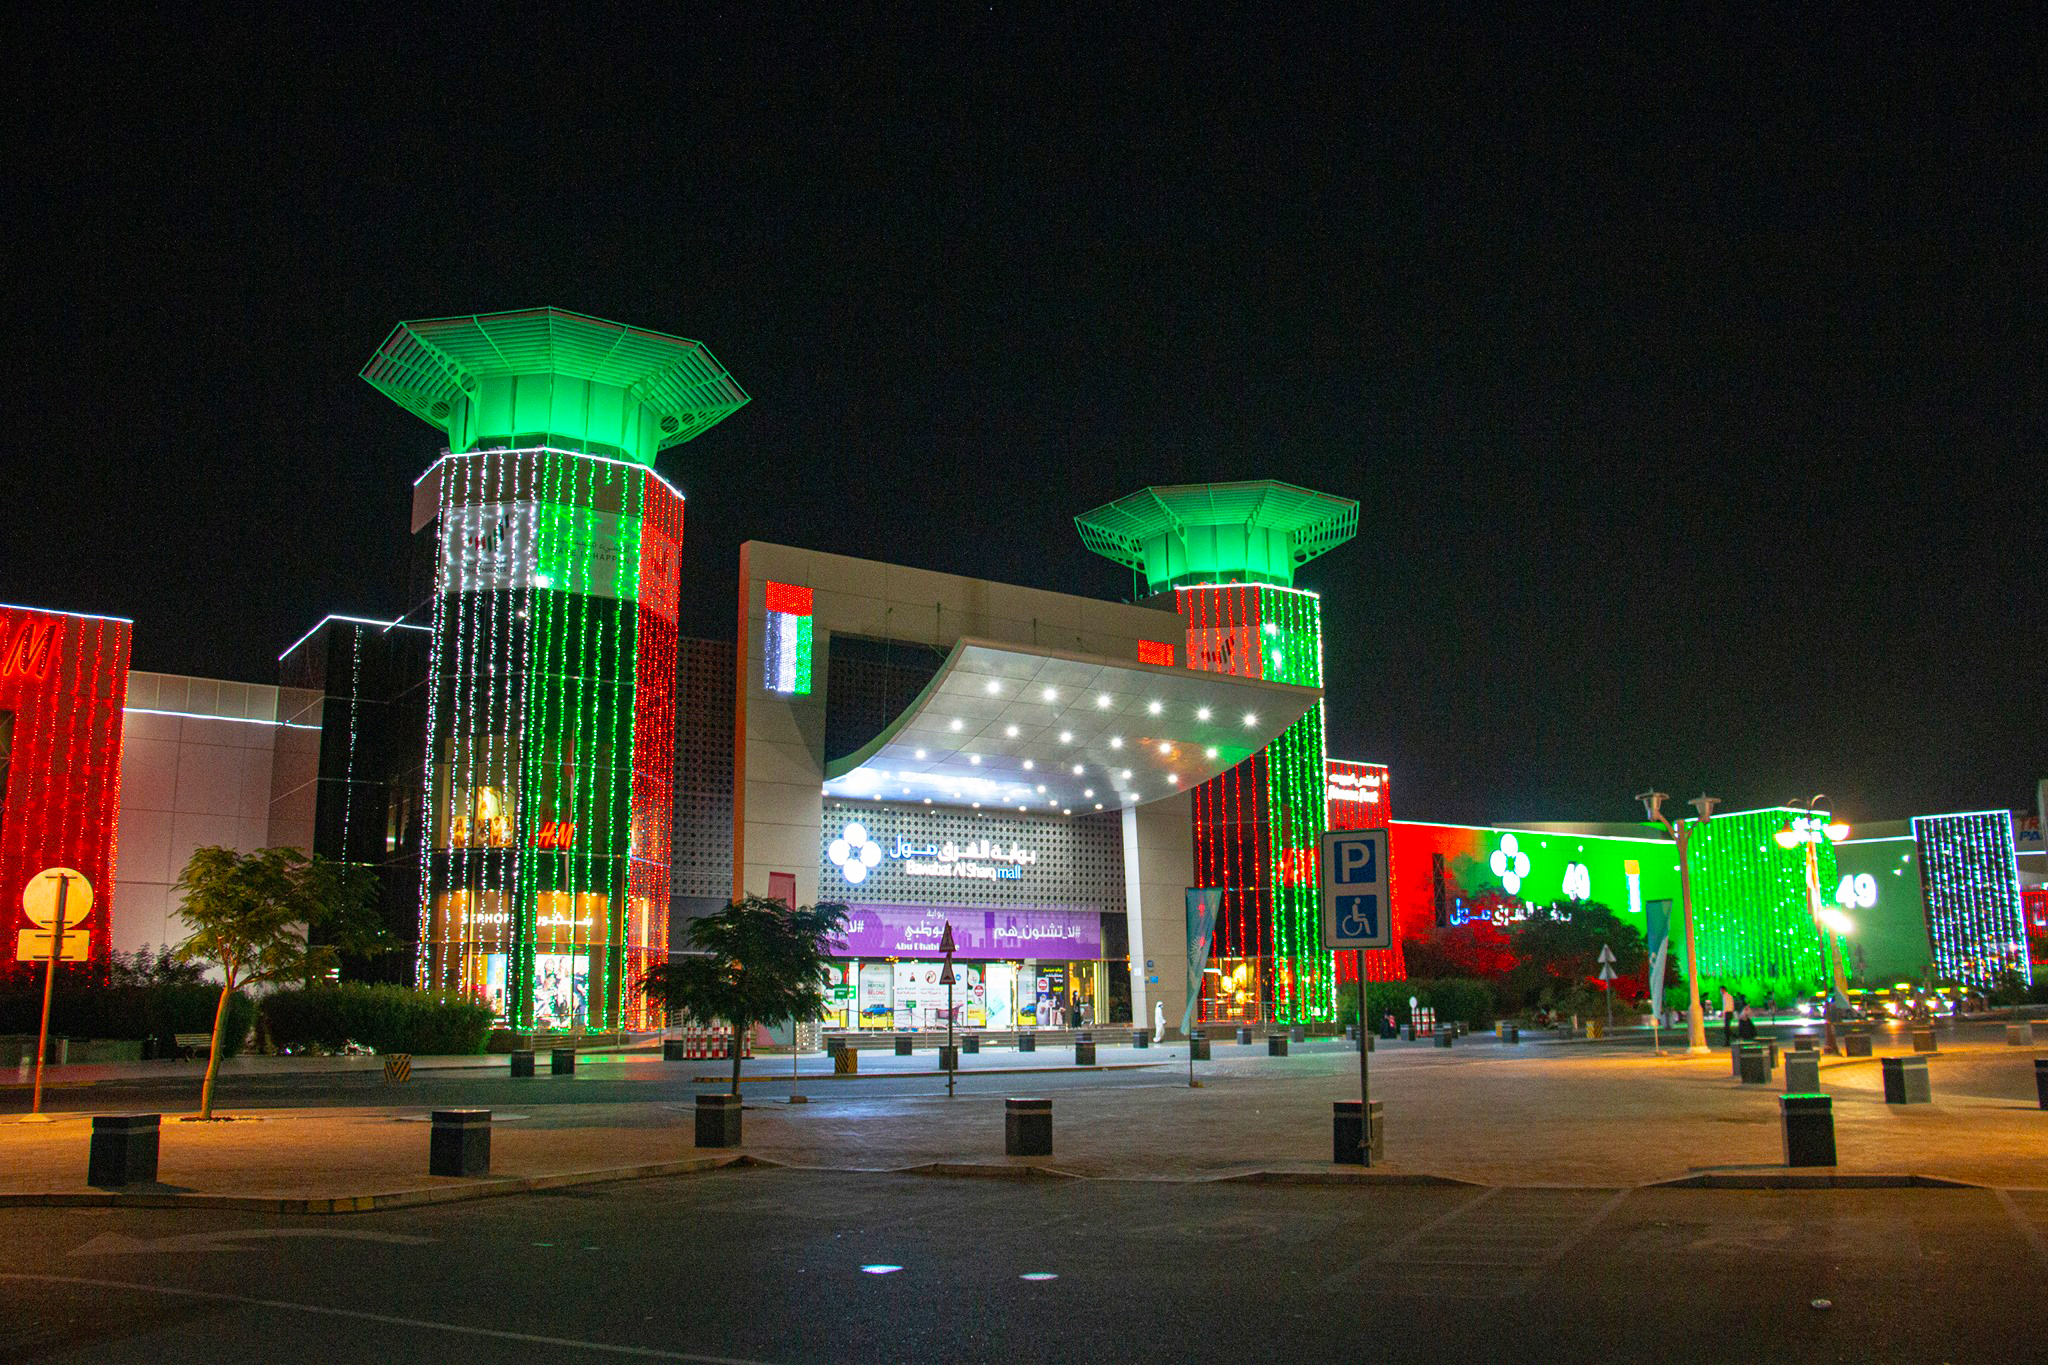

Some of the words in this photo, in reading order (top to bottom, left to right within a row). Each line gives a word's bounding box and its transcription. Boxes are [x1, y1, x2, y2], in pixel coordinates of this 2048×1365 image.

[551, 546, 577, 557] MAE
[593, 552, 630, 564] HAPPN
[537, 822, 576, 849] H&M
[889, 833, 938, 859] مول
[937, 839, 991, 862] الشرق
[990, 841, 1036, 865] بوابة
[905, 859, 953, 877] Bawabat
[953, 861, 966, 878] Al
[966, 862, 996, 882] Sharq
[997, 864, 1022, 880] mall
[1341, 842, 1371, 883] P
[1835, 873, 1878, 909] 49
[905, 918, 948, 941] بوظبي
[895, 942, 913, 951] Abu
[913, 942, 940, 951] Dhabi
